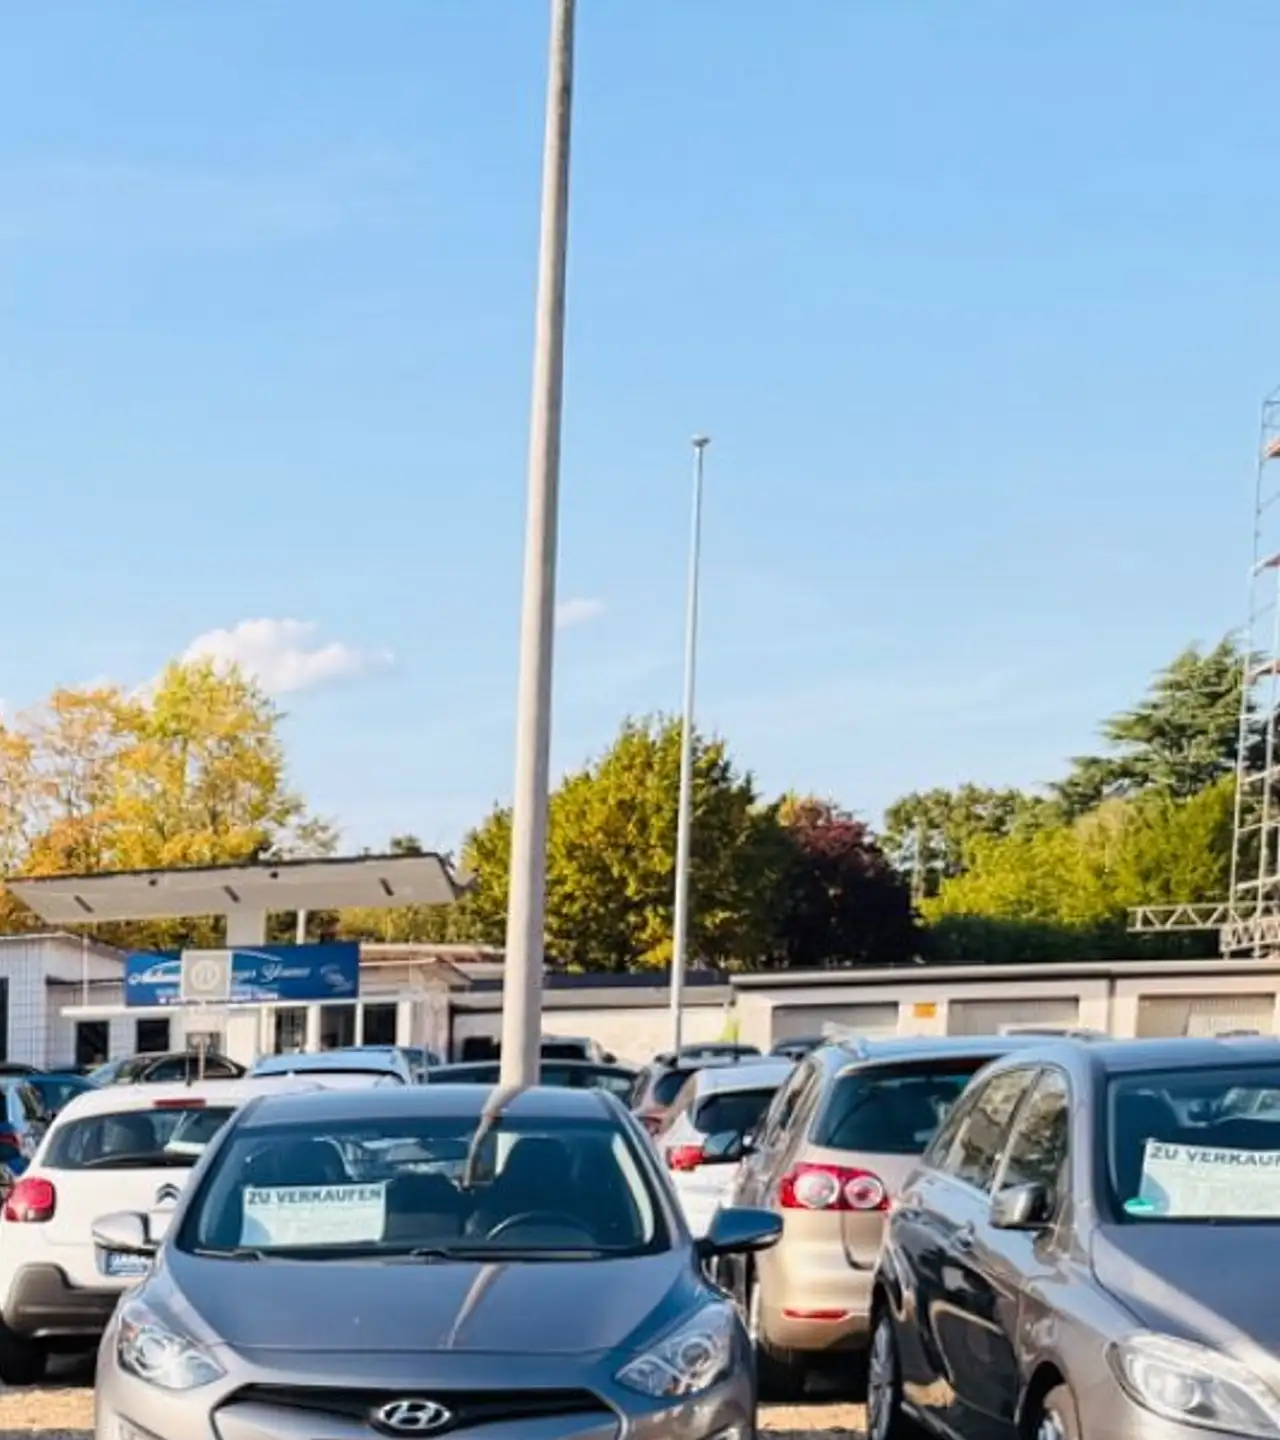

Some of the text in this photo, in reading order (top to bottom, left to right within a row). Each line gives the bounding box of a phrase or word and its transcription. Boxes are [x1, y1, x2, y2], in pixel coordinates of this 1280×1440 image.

[1150, 1145, 1178, 1160] ZU
[248, 1188, 382, 1206] ZU VERKAUFEN
